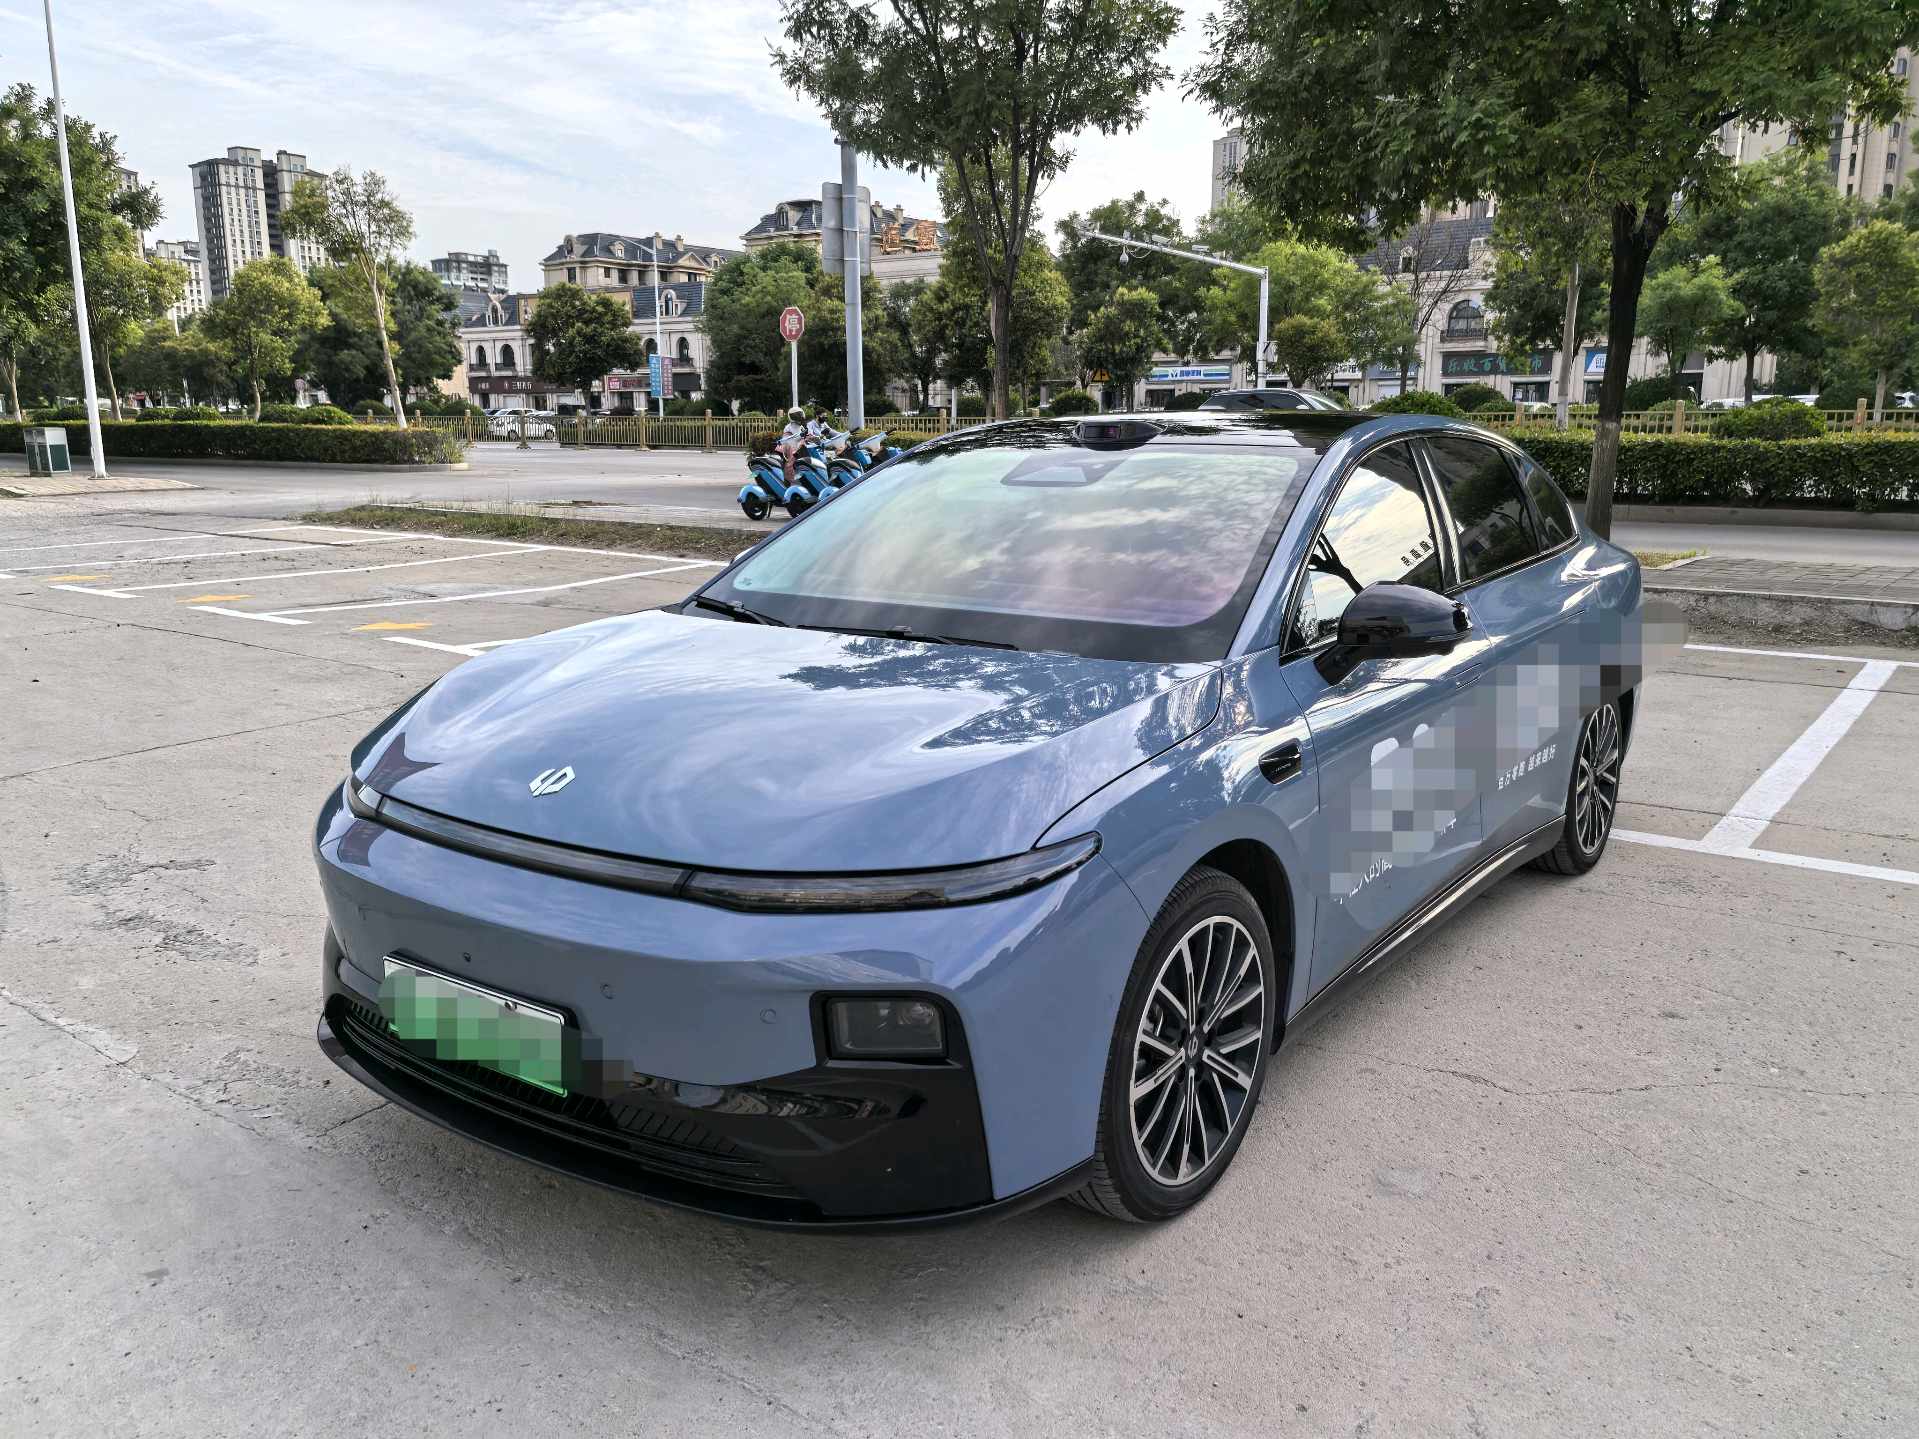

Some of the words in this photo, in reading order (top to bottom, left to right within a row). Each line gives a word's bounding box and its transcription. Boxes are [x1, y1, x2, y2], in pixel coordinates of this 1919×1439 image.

[784, 314, 800, 336] 停
[1527, 743, 1557, 772] 越来越好
